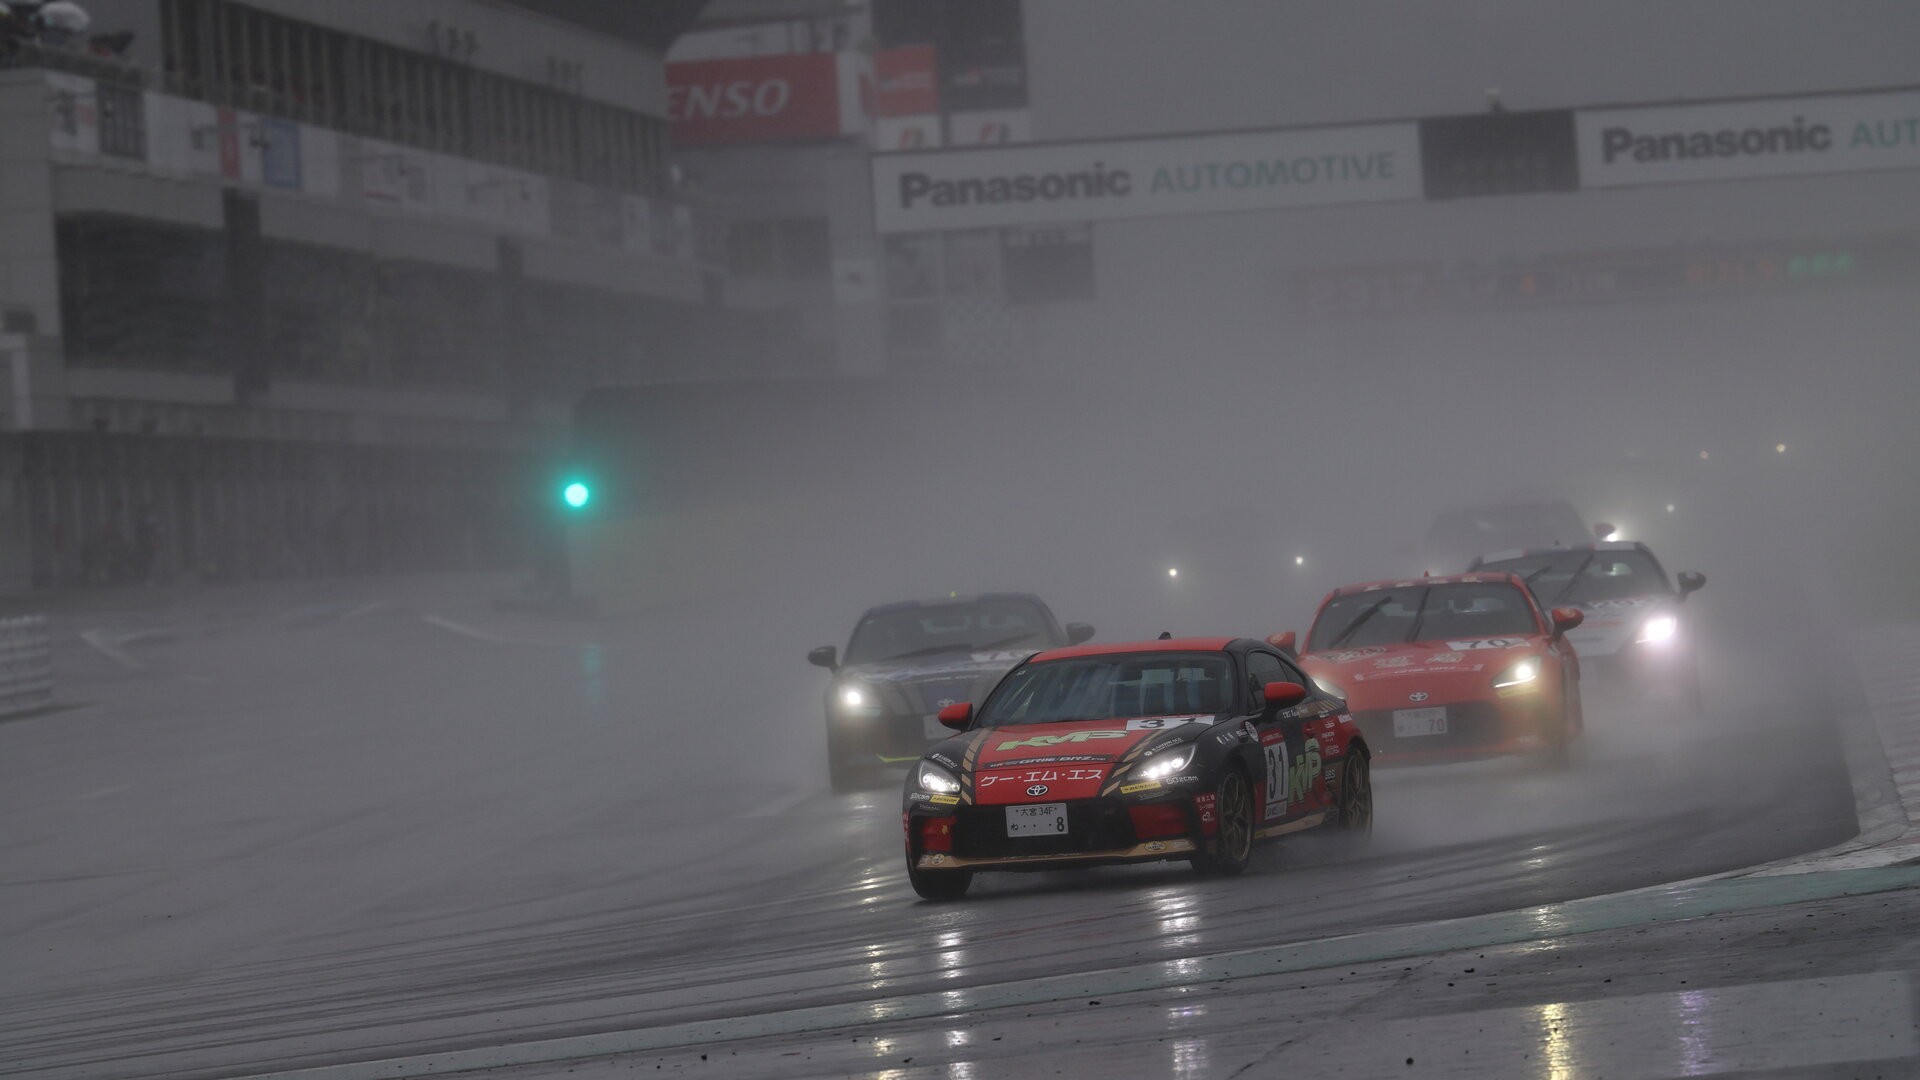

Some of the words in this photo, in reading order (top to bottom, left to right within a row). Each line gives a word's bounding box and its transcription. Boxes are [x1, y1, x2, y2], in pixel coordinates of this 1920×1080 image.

[1601, 115, 1832, 163] Panasonic
[899, 161, 1133, 209] Panasonic
[1150, 151, 1397, 194] AUTOMOTIVE
[1428, 718, 1445, 732] 70
[981, 769, 1103, 787] ケー・エム・エス
[1268, 745, 1284, 800] 31
